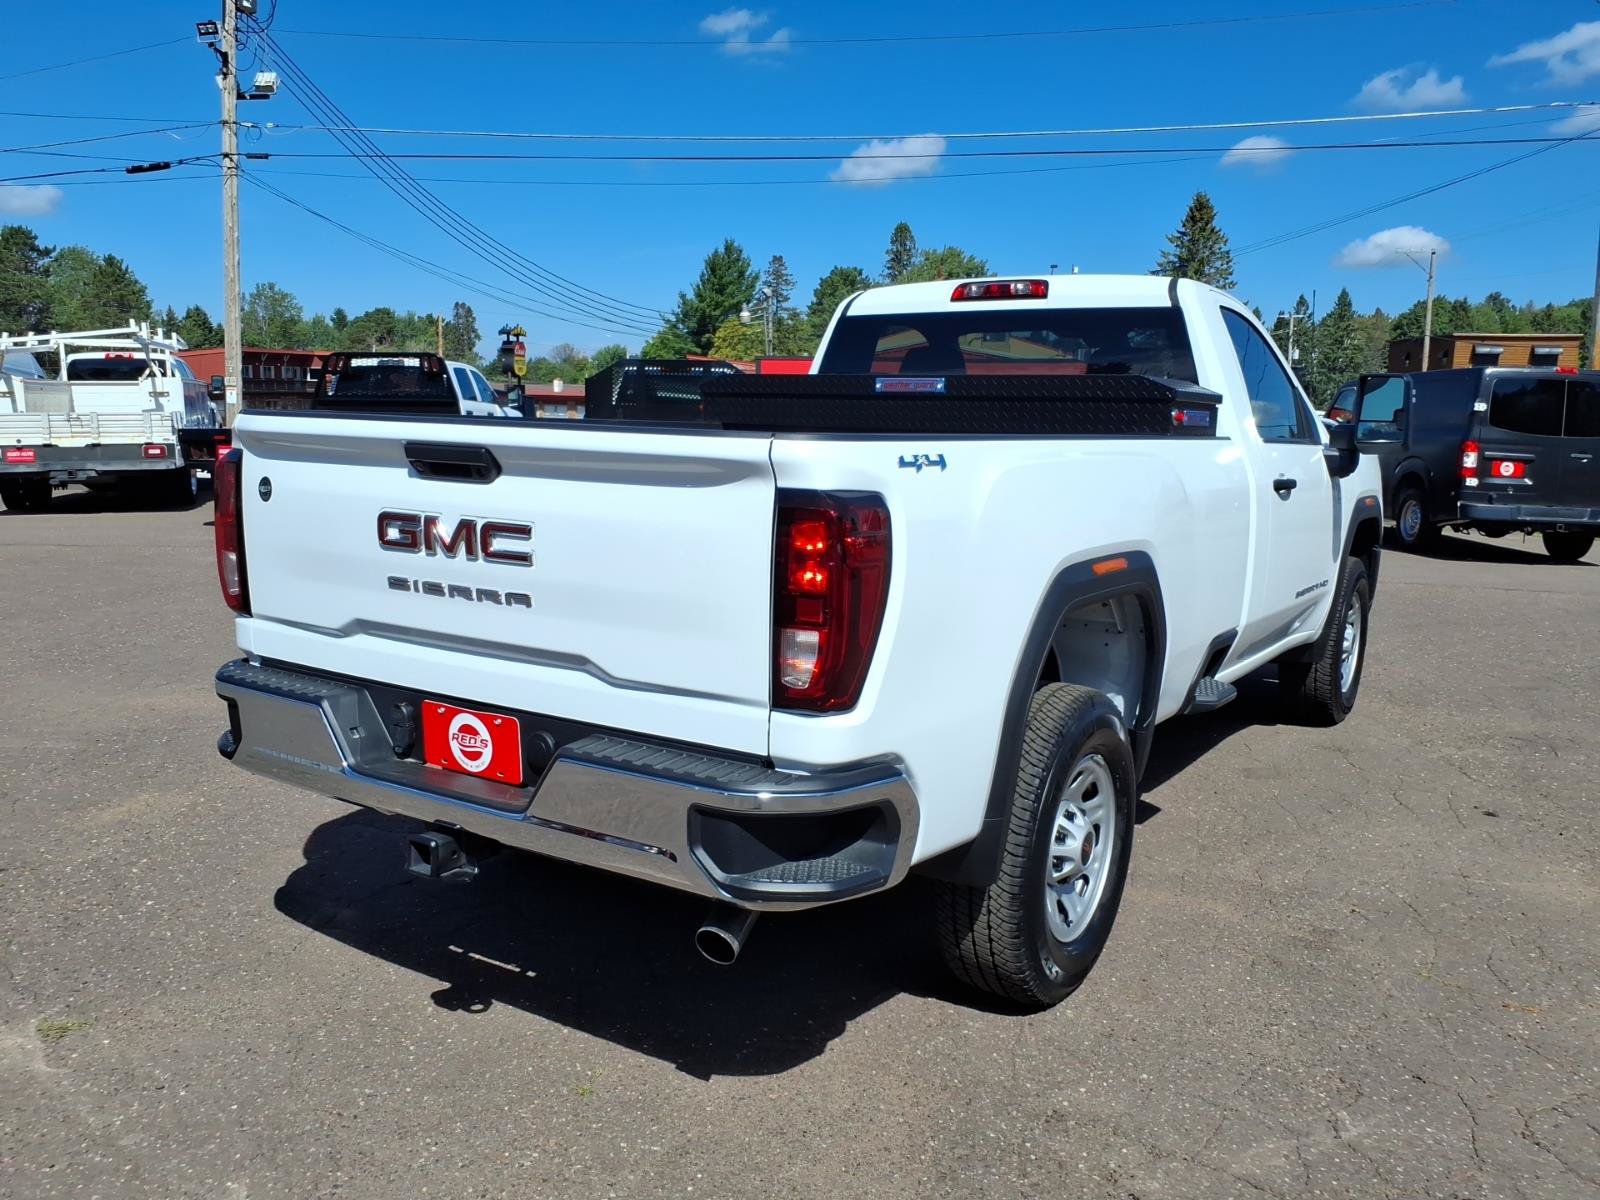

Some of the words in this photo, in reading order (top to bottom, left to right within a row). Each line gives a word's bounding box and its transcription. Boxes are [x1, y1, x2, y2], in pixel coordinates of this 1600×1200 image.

[377, 507, 535, 568] GMC
[387, 575, 532, 608] SIERRA
[451, 732, 489, 749] RED'S
